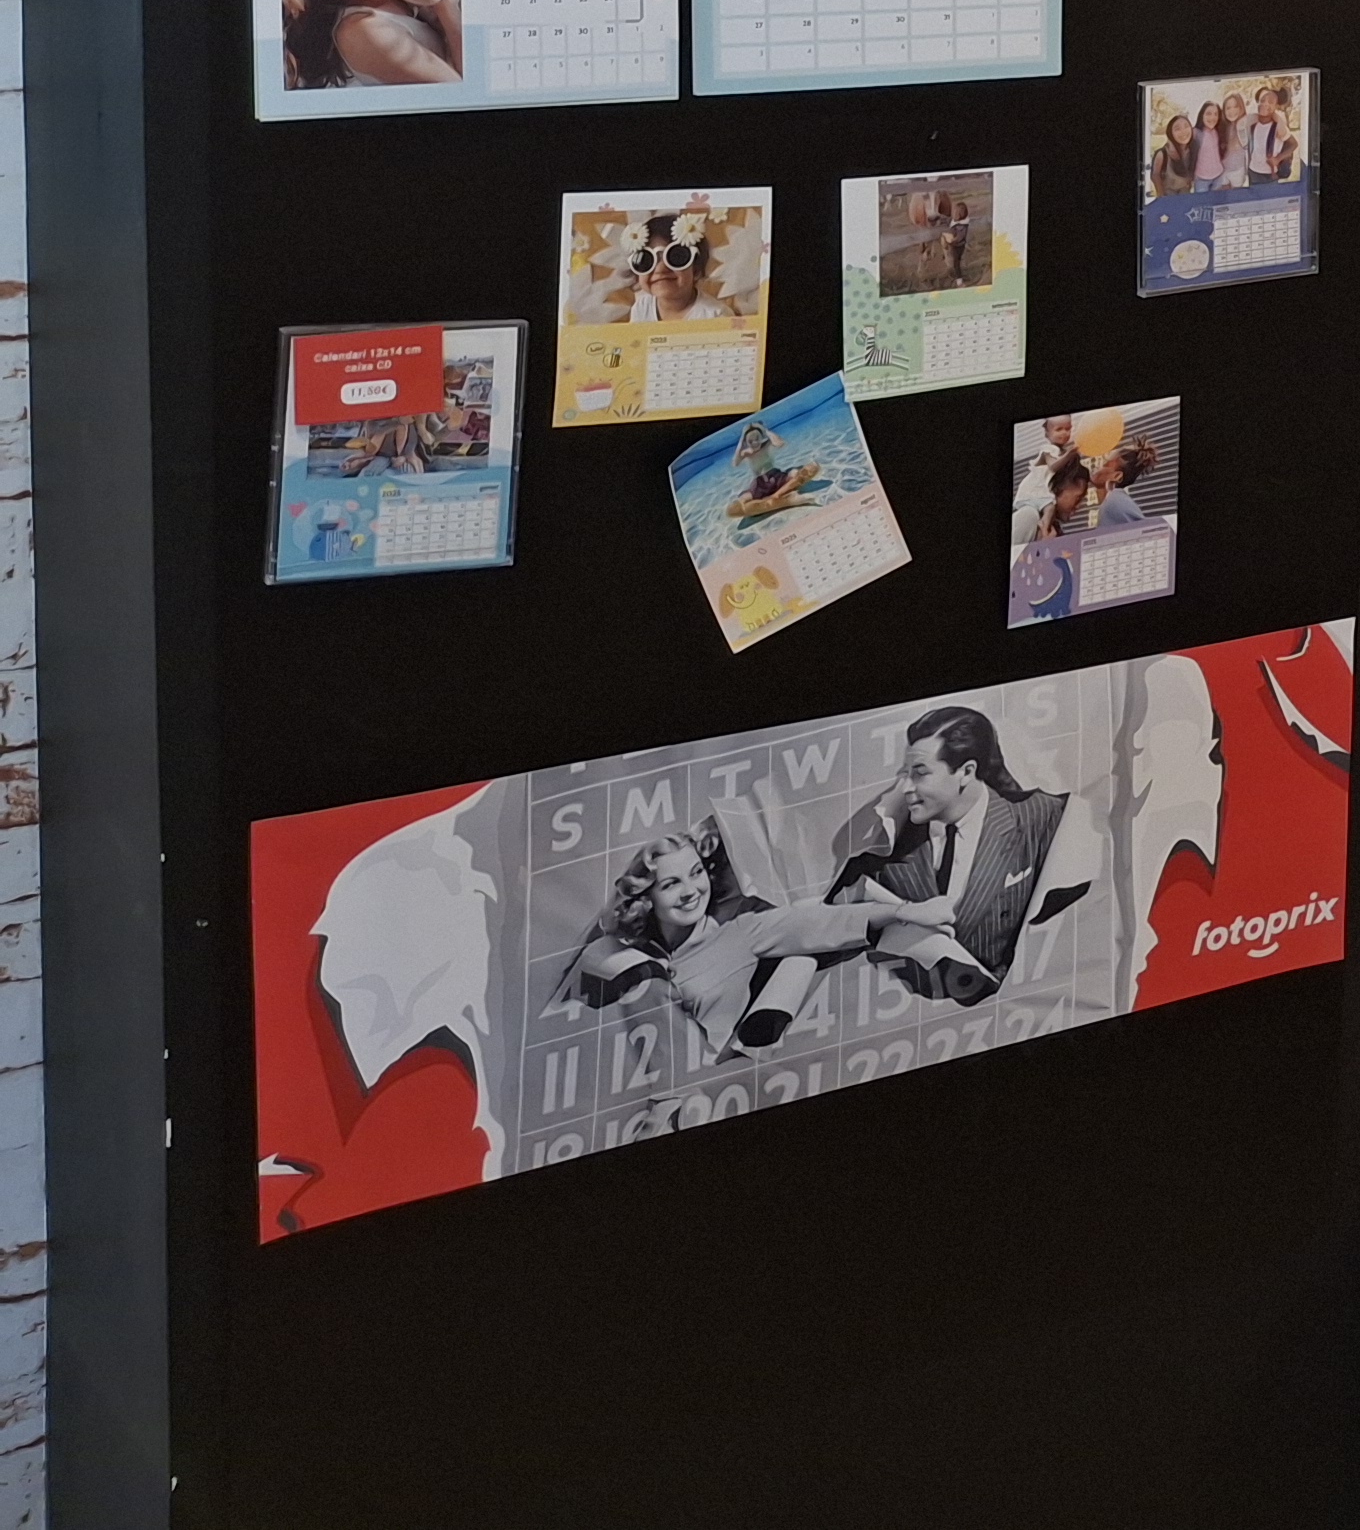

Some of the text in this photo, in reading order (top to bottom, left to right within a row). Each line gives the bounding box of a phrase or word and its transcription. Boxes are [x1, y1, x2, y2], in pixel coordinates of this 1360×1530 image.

[314, 350, 367, 363] Calendari
[404, 345, 422, 354] cm
[551, 803, 583, 852] S
[620, 780, 675, 833] M
[783, 739, 841, 790] W
[1027, 683, 1057, 726] S
[1192, 891, 1339, 957] fotoprix
[542, 1023, 661, 1114] 11 12
